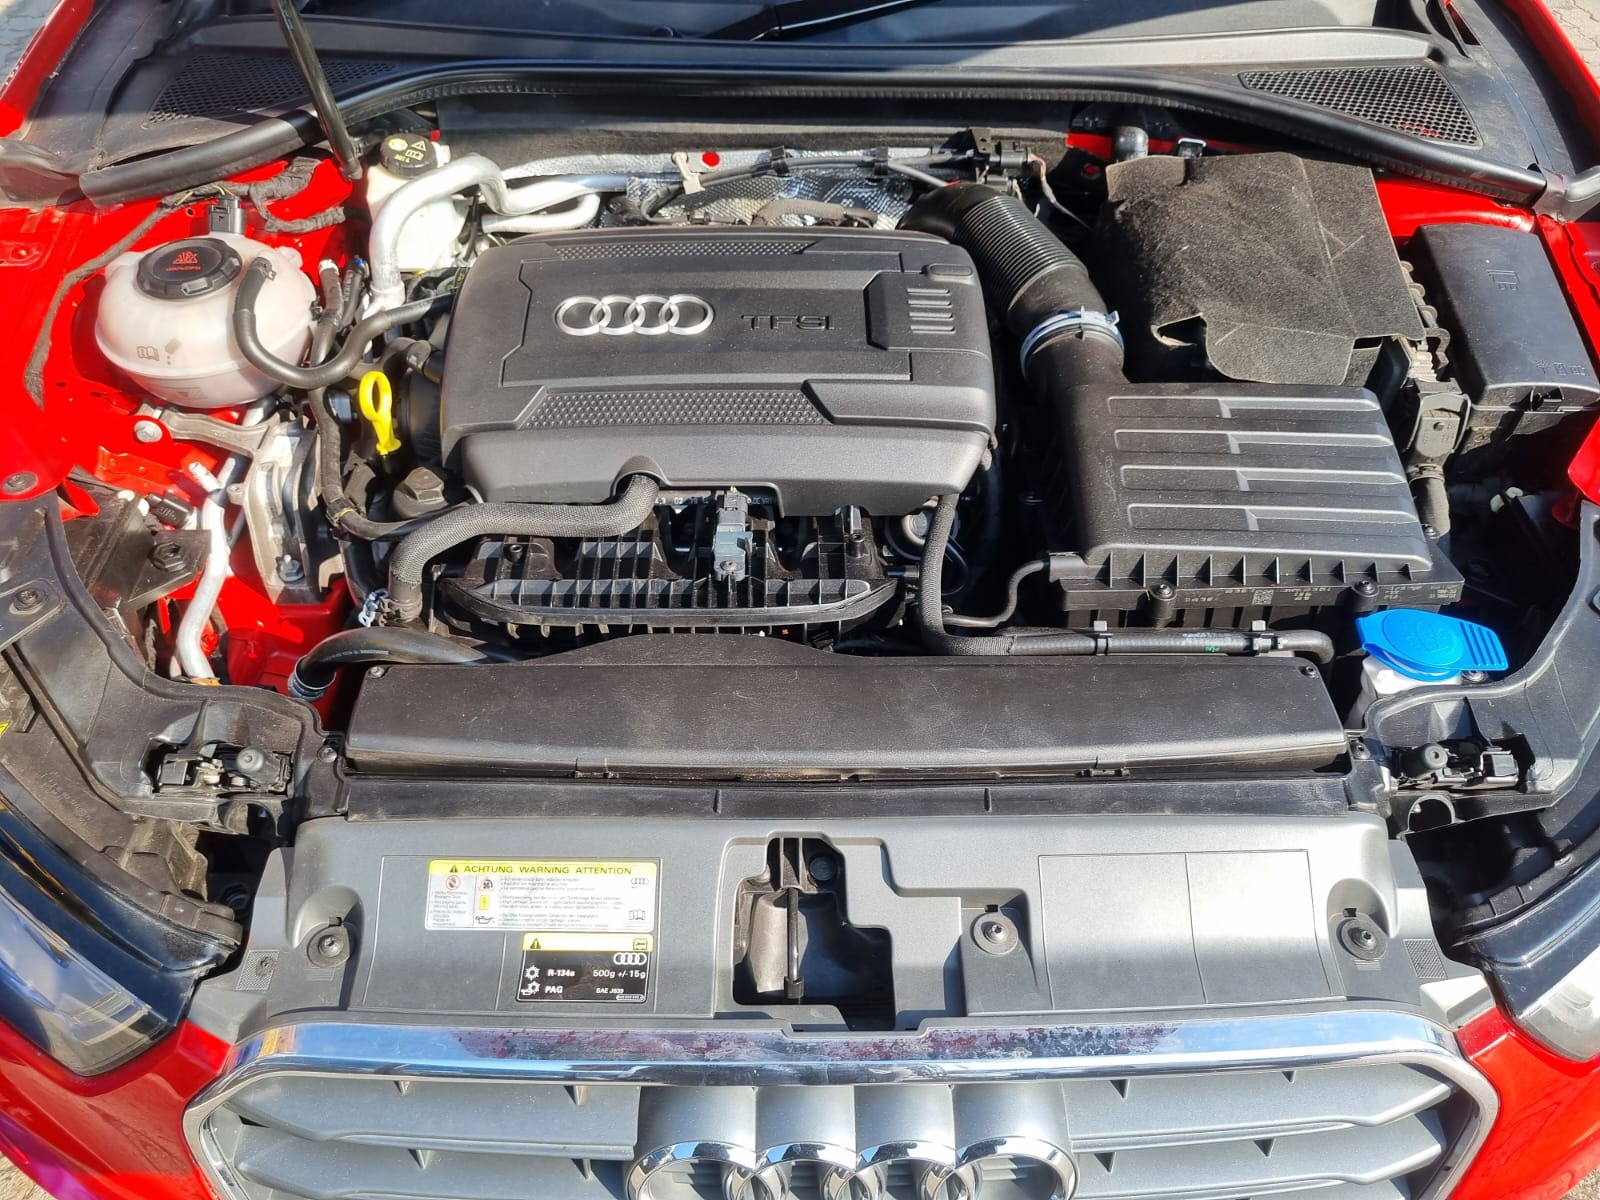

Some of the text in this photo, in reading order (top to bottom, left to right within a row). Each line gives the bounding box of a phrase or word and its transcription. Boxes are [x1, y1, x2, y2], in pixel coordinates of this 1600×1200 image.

[740, 314, 836, 331] TFSI
[464, 865, 632, 875] ACHTUNG WARNING ATTENTION
[547, 968, 576, 977] R-134a
[592, 969, 616, 979] 500g
[544, 985, 564, 994] PAG
